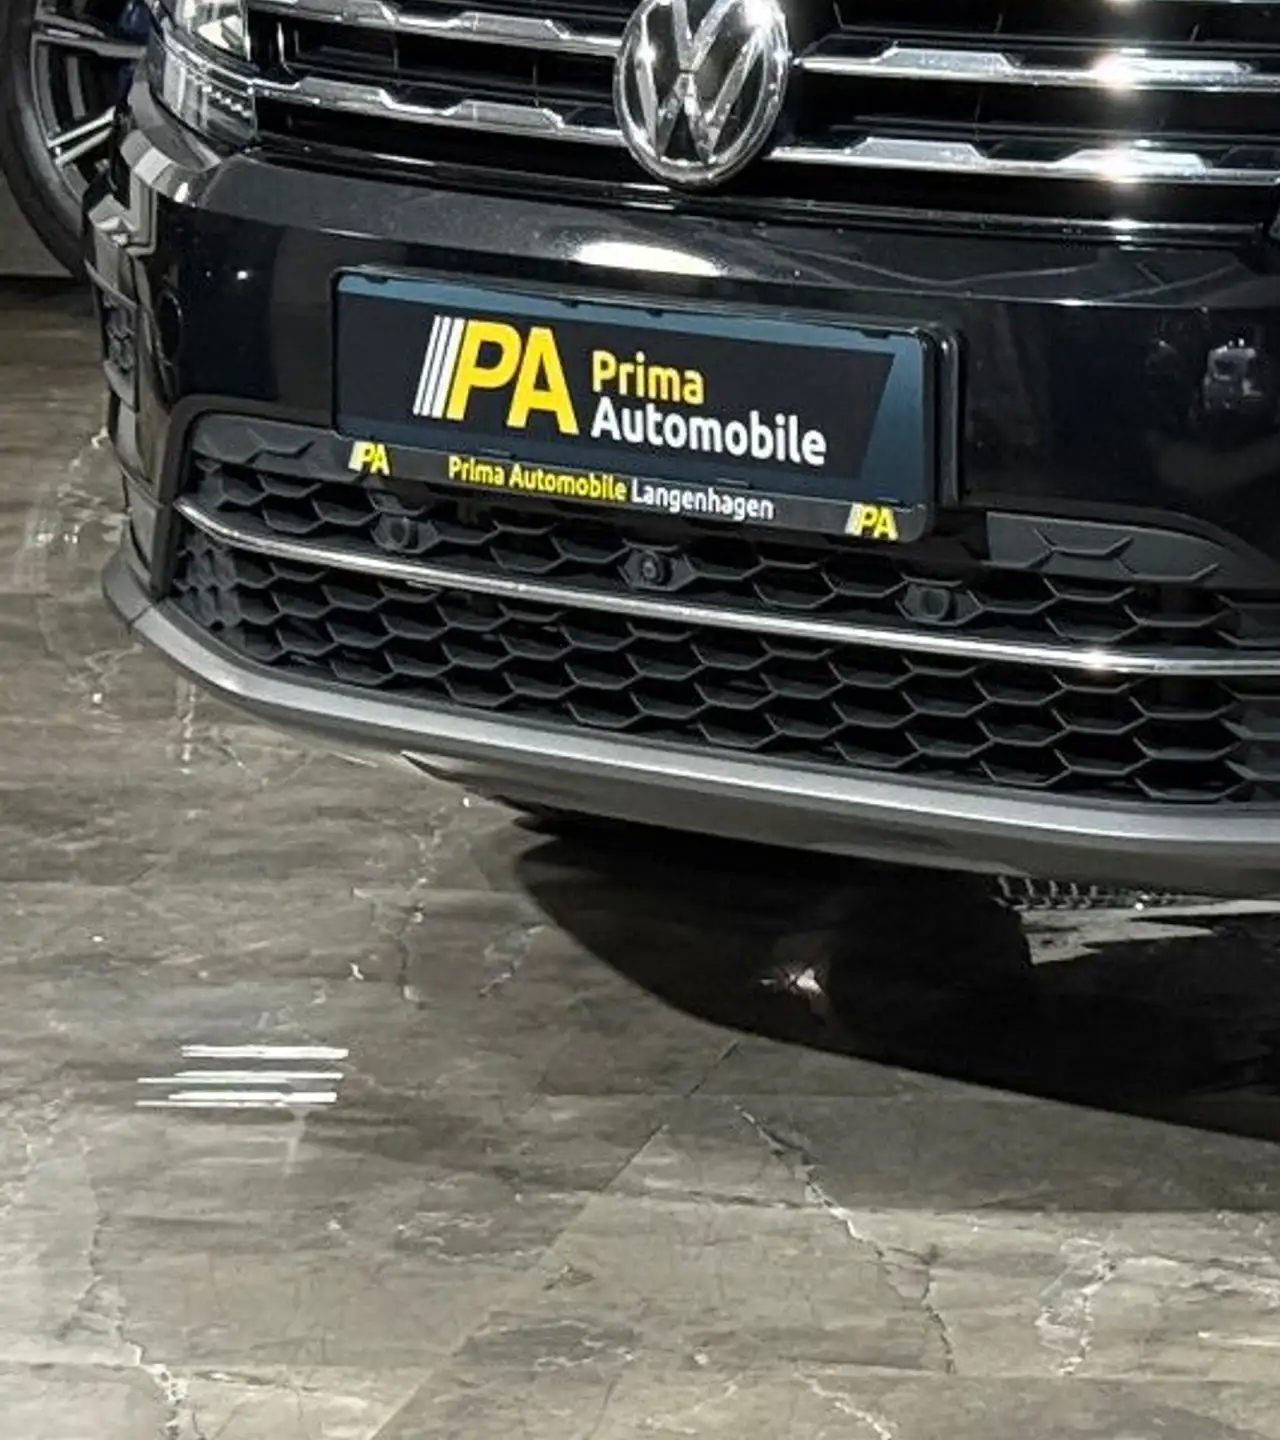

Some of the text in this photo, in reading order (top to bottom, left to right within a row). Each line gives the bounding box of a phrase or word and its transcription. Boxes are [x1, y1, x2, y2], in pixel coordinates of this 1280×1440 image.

[447, 319, 578, 435] PA
[592, 351, 704, 405] Prima
[359, 441, 390, 476] PA
[590, 396, 827, 465] Automobile
[448, 456, 775, 521] Prima Automobile Langenhagen
[853, 505, 898, 540] PA
